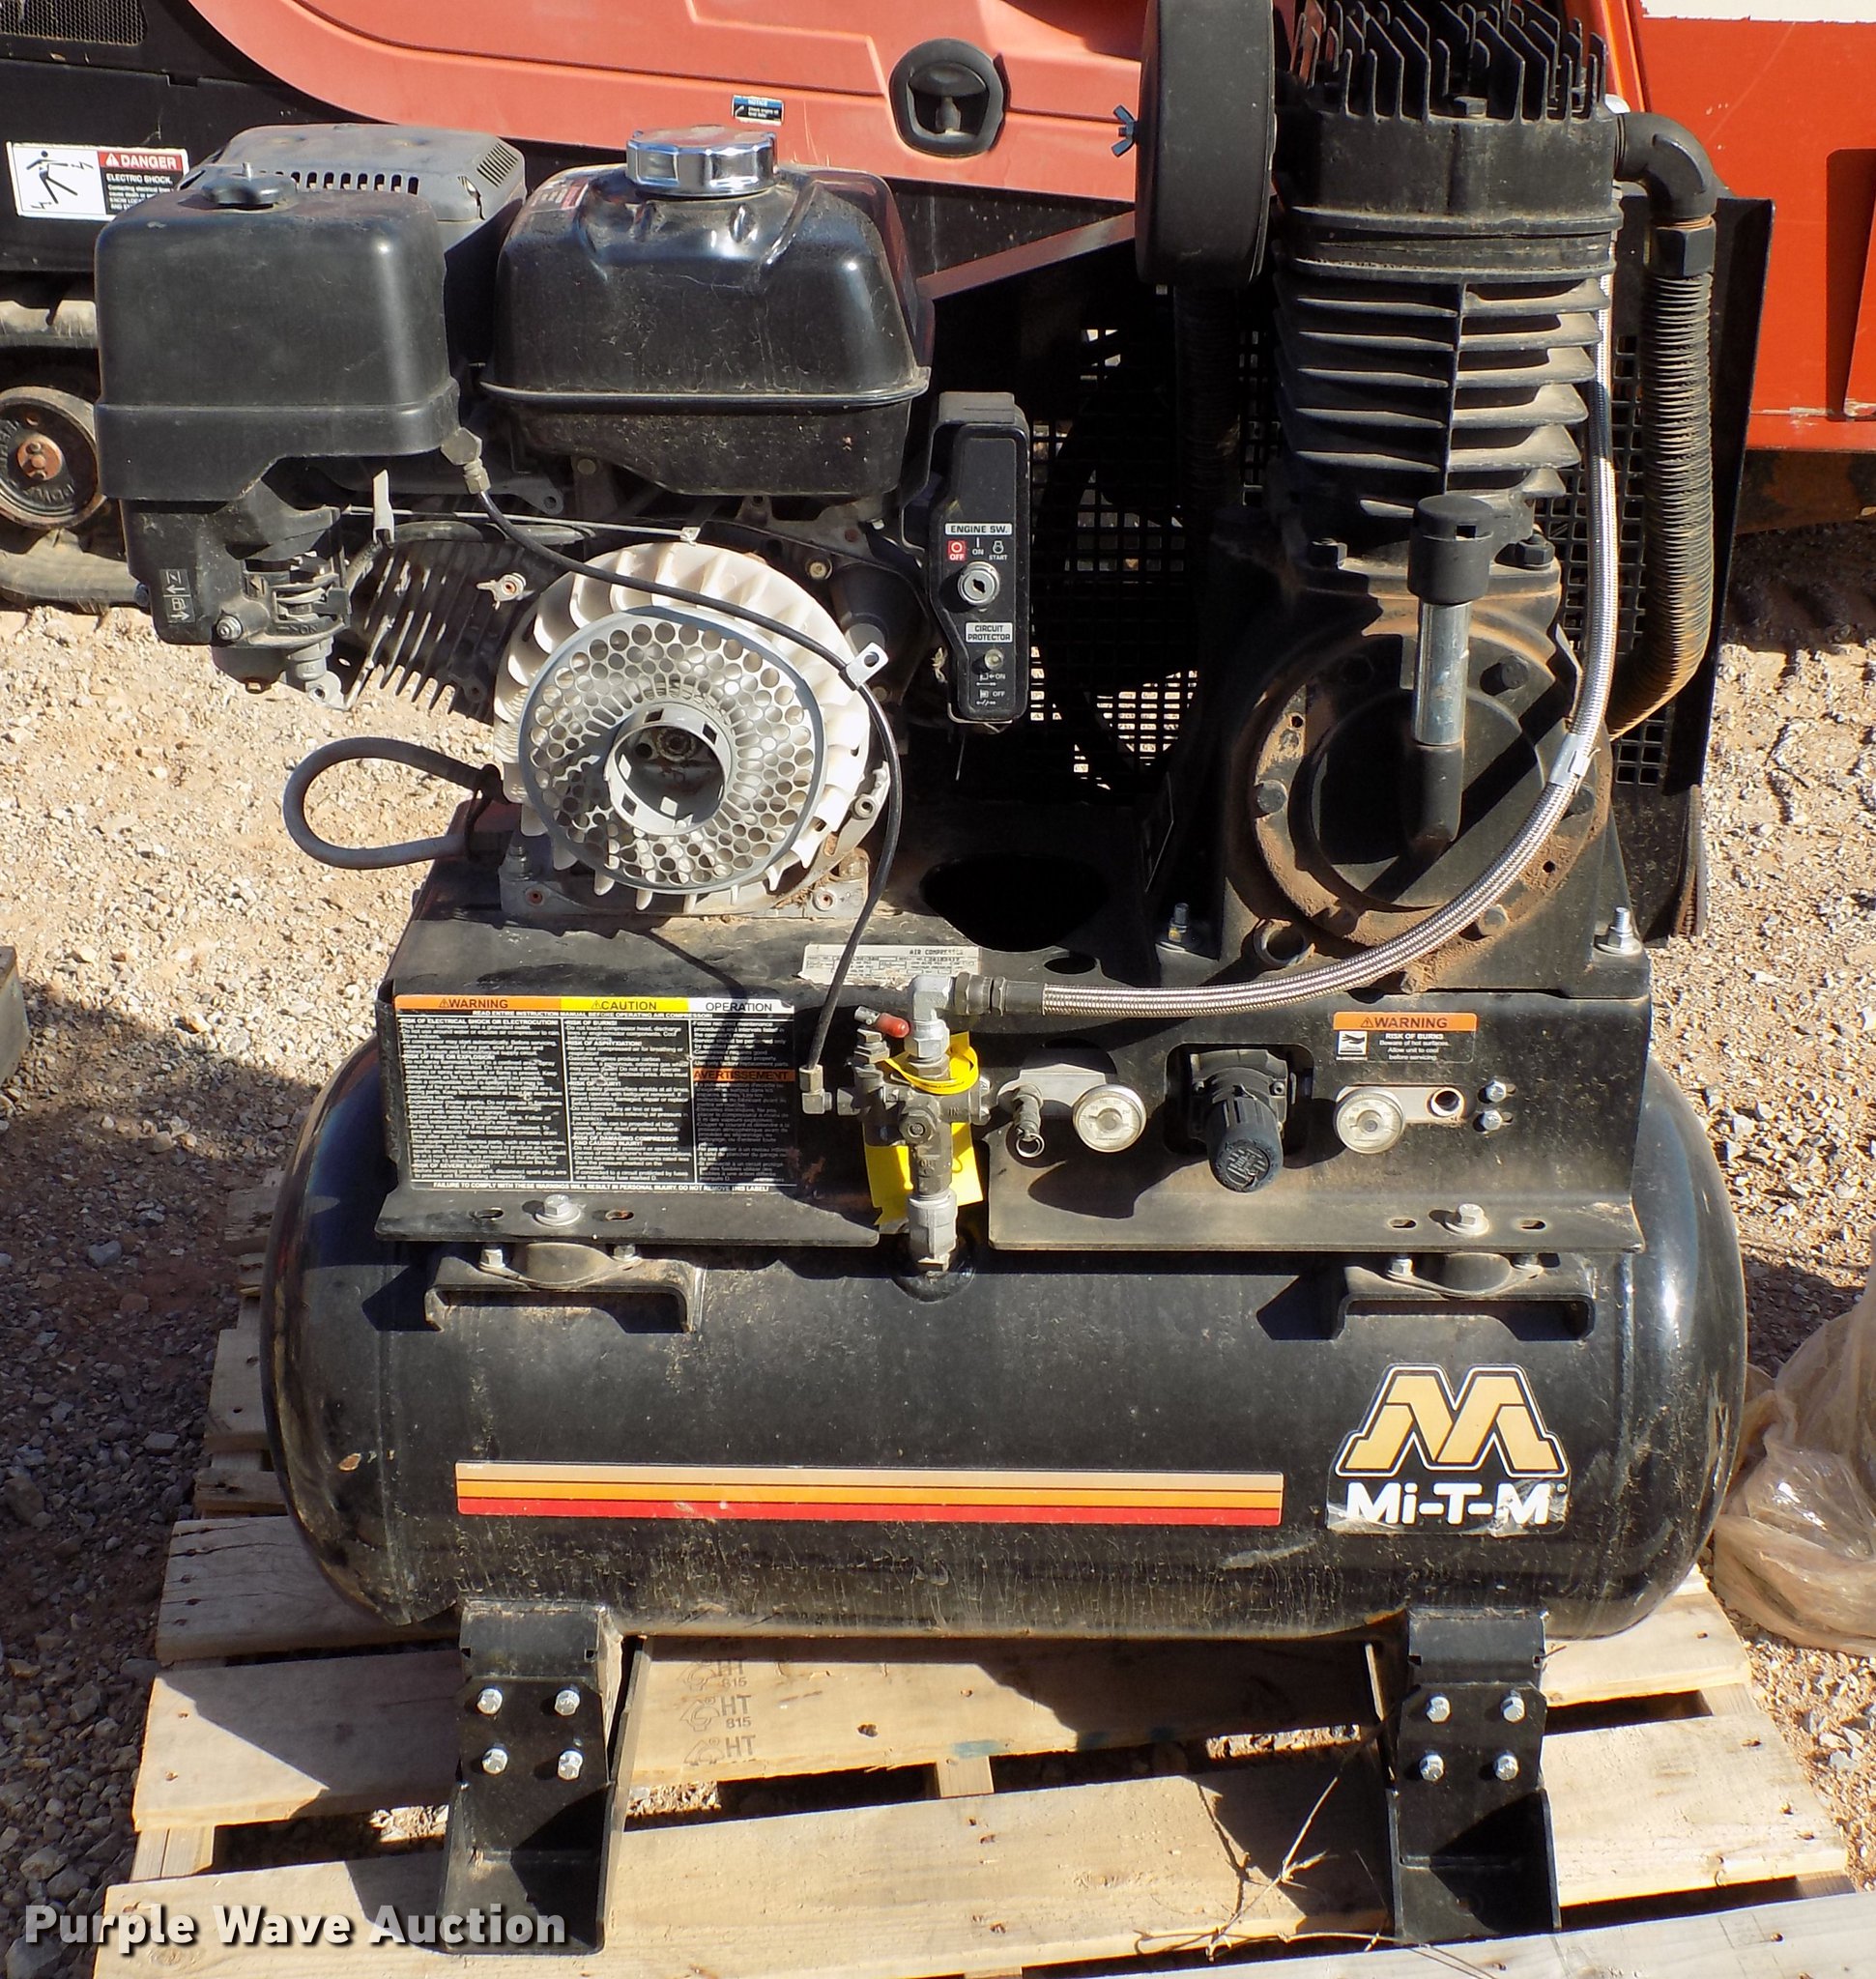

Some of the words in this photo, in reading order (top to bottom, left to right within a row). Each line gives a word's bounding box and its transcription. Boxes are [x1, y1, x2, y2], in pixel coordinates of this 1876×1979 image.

[120, 154, 177, 170] DANGER
[106, 173, 143, 183] ELECTRIC
[144, 175, 173, 185] SHOCK.
[449, 999, 508, 1008] WARNING
[601, 1001, 657, 1010] CAUTION
[705, 1002, 772, 1011] OPERATION
[1374, 1018, 1448, 1028] WARNING
[694, 1070, 788, 1079] AVERTISSEMENT
[1346, 1482, 1550, 1525] Mi-T-M
[722, 1678, 747, 1687] 815
[721, 1695, 751, 1716] HT
[726, 1717, 751, 1729] 815
[726, 1735, 756, 1757] HT
